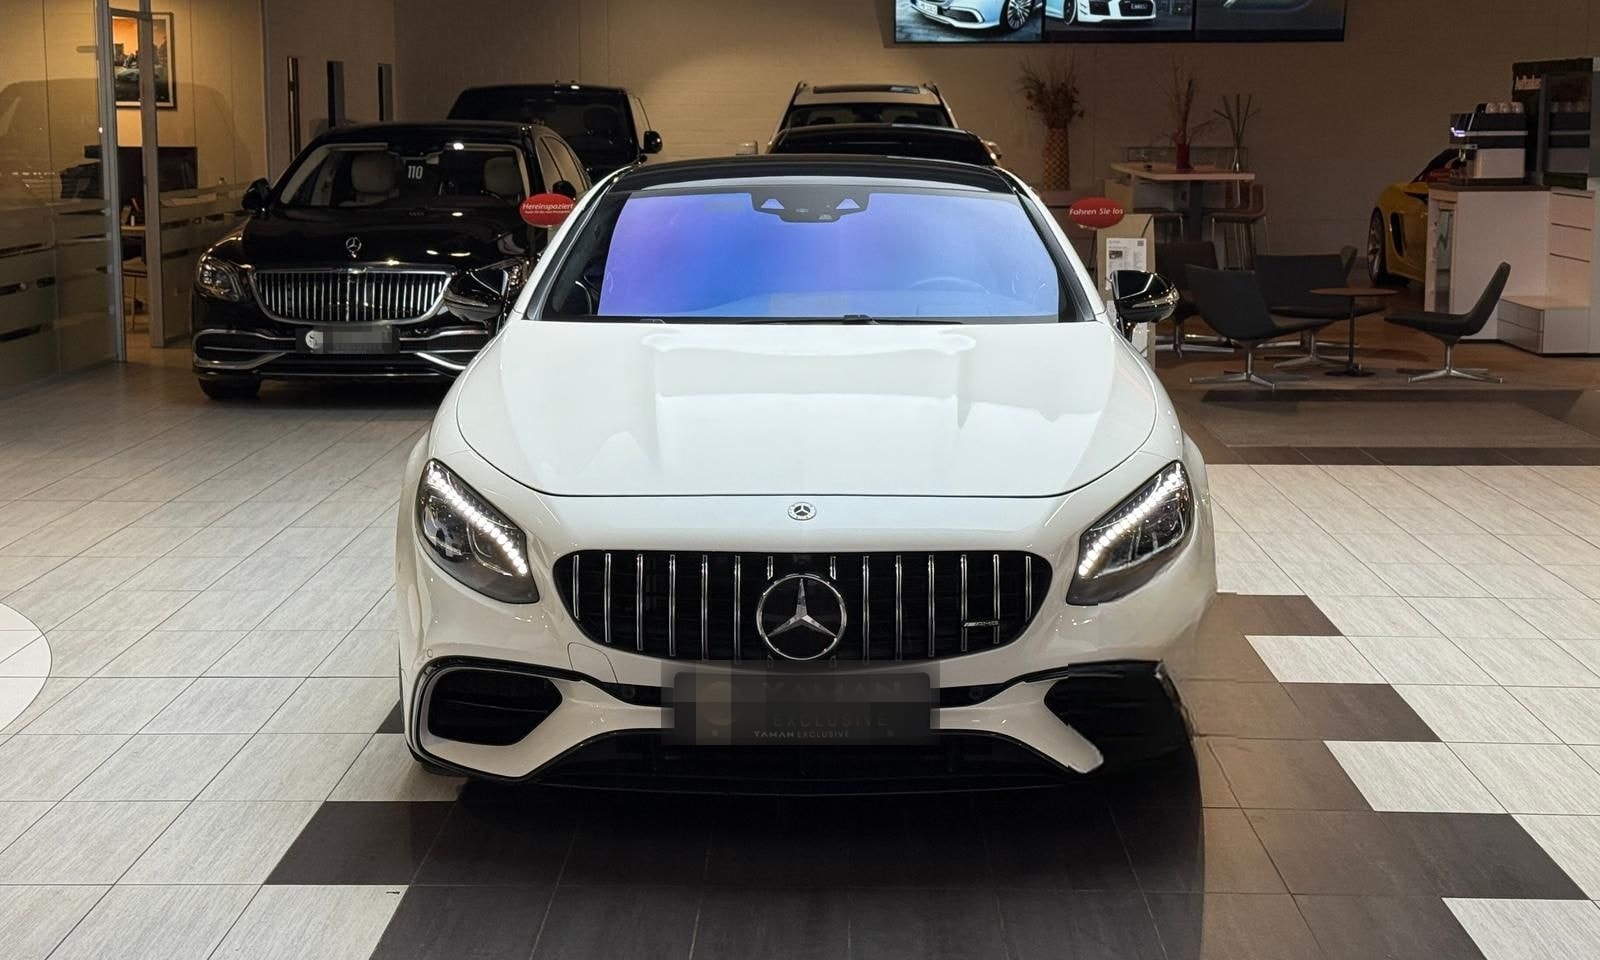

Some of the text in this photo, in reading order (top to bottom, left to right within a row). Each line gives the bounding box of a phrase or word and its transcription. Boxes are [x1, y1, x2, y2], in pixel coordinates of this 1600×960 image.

[407, 165, 424, 180] 110
[522, 203, 574, 211] Hereinspaziert
[1069, 207, 1124, 216] Fahren Sie los
[773, 713, 888, 727] EXCLUSIVE
[753, 730, 850, 738] YAMAN EXCLUSIVE
